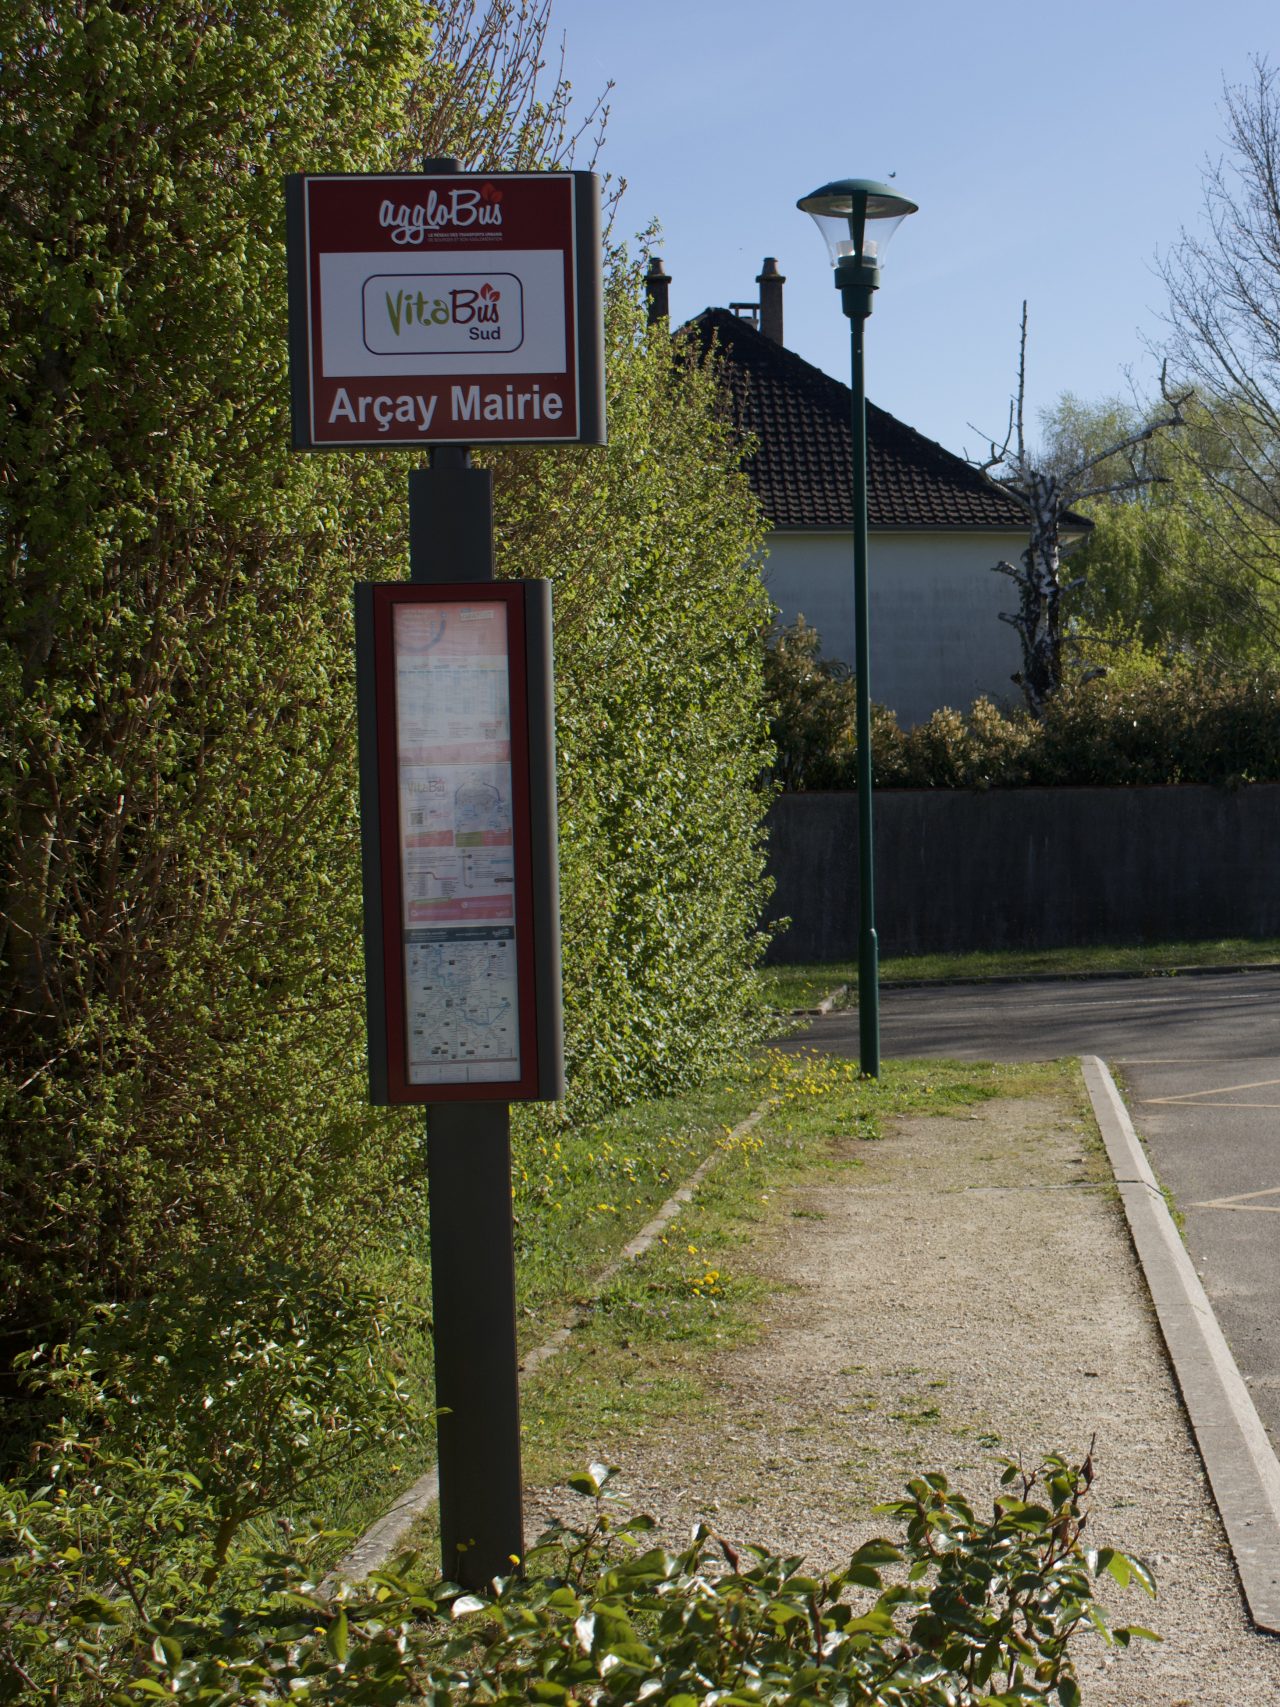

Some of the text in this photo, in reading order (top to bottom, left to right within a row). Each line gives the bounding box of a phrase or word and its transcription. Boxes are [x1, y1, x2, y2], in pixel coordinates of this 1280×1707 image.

[379, 189, 503, 244] aggloBus
[386, 289, 500, 336] VitaBus
[469, 327, 501, 340] Sud
[328, 384, 563, 432] Arçay Mairie
